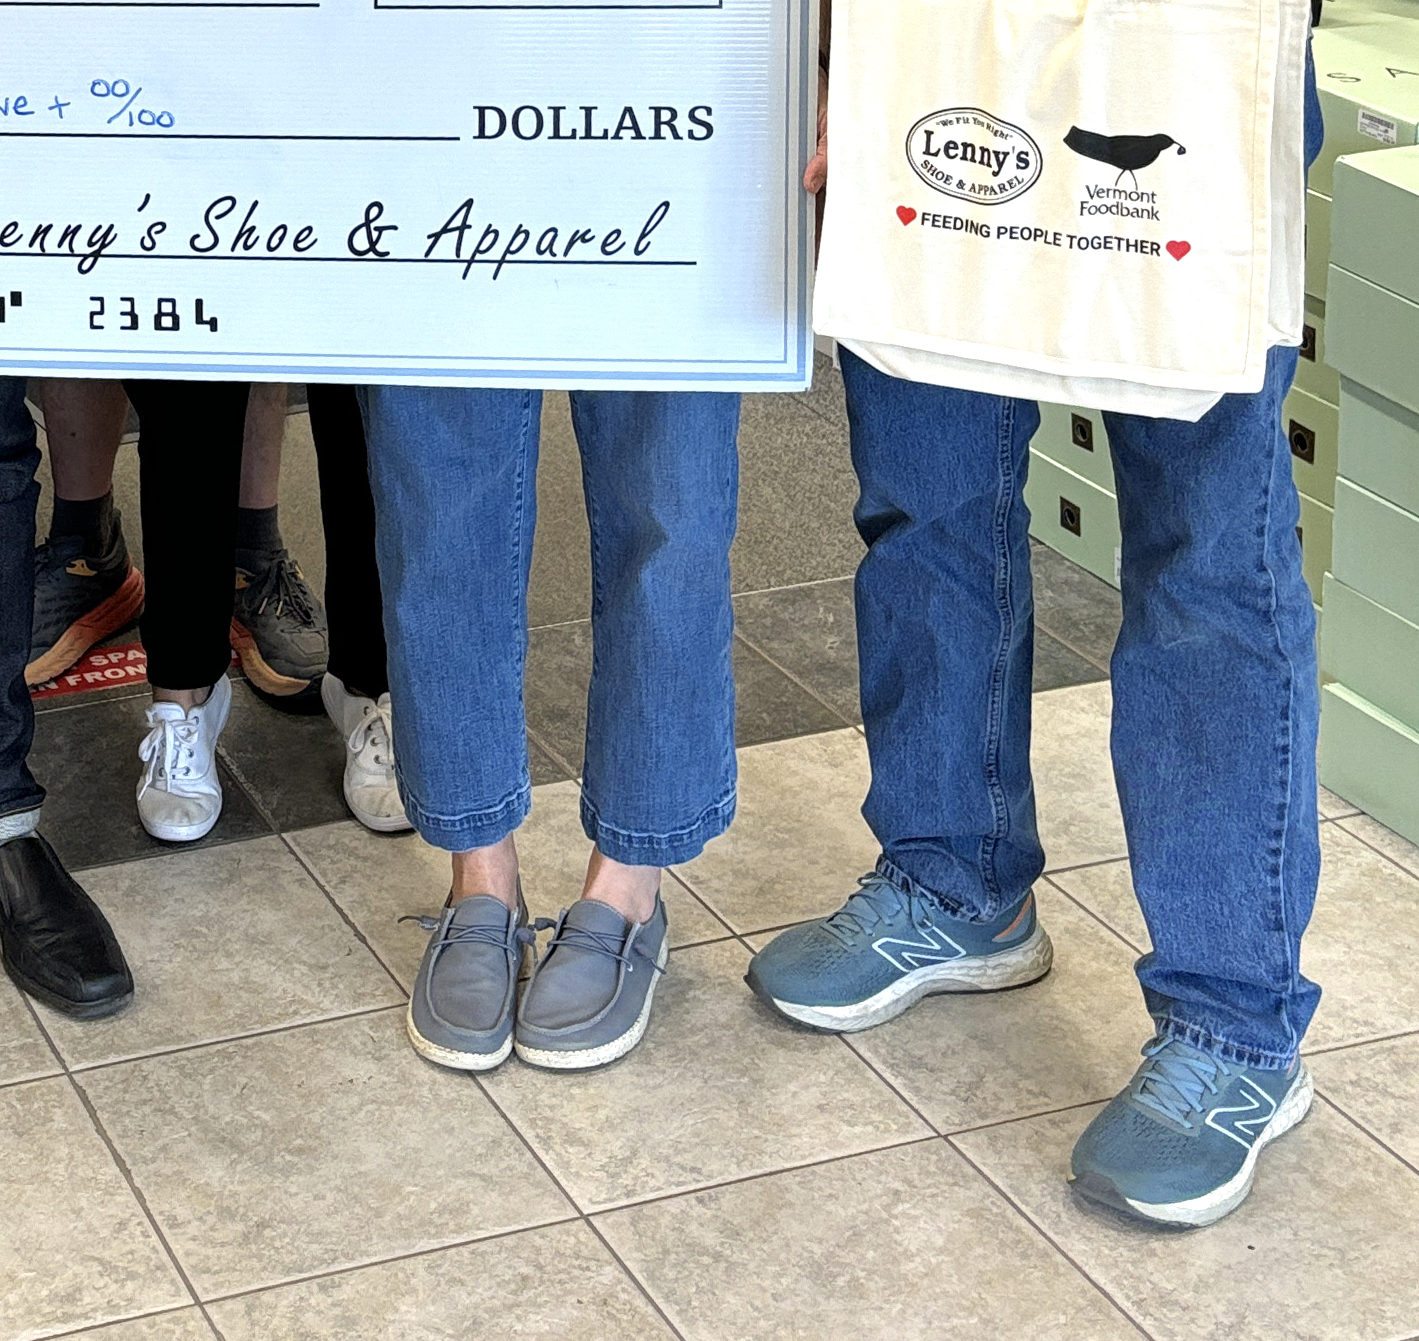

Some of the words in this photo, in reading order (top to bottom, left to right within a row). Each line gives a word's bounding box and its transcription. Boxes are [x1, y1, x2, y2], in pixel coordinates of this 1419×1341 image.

[473, 105, 715, 141] DOLLARS
[956, 116, 970, 124] Fit
[972, 116, 985, 127] You
[922, 129, 1030, 177] Lenny's
[921, 159, 953, 185] SHOE
[956, 179, 966, 190] &
[968, 174, 1025, 196] APPAREL
[1085, 185, 1157, 204] Vermont
[1080, 201, 1160, 221] Foodbank
[189, 196, 319, 254] Shoe
[347, 201, 399, 258] &
[424, 197, 671, 281] Apparel
[921, 212, 991, 238] FEEDING
[997, 225, 1062, 247] PEOPLE
[1066, 234, 1161, 256] TOGETHER
[89, 296, 219, 333] 2384
[64, 663, 147, 687] FRON
[89, 649, 147, 666] SPA
